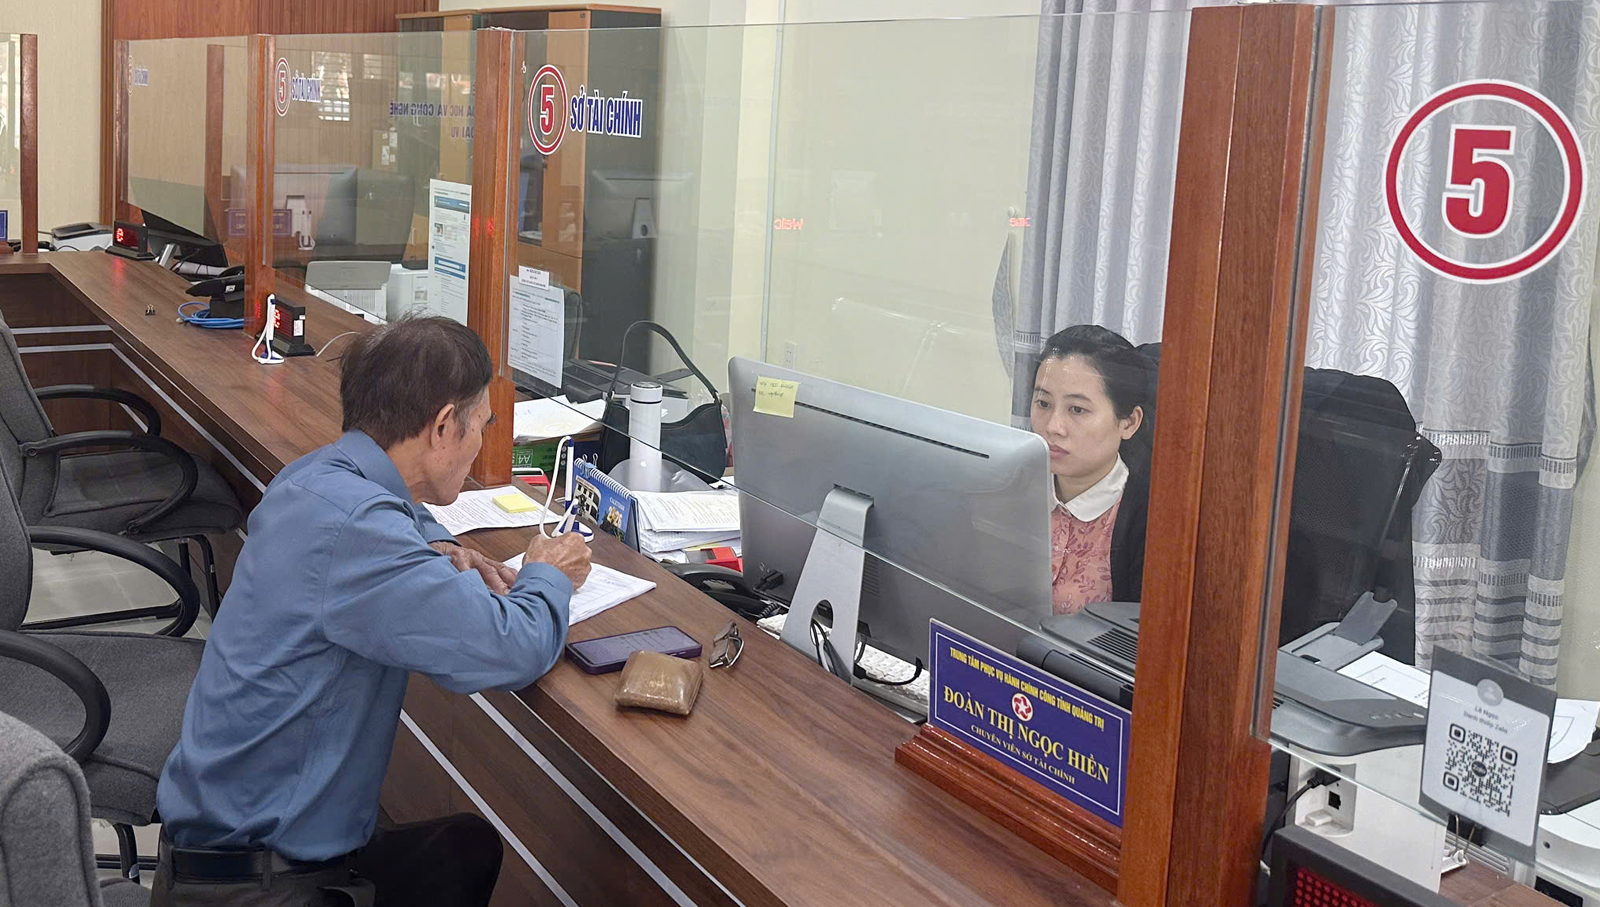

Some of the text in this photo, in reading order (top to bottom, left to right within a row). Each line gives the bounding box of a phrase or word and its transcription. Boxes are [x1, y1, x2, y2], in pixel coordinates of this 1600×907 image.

[279, 70, 286, 103] 5
[540, 84, 555, 135] 5
[570, 84, 643, 138] SỞ TÀI CHÍNH
[1441, 124, 1516, 239] 5
[950, 646, 1105, 732] TRUNG TÂM PHỤC VỤ HÀNH CHÍNH CÔNG TỈNH QUẢNG TRỊ
[944, 685, 1110, 785] ĐOÀN THỊ NGỌC HIỀN
[971, 724, 1001, 745] CHUYÊN
[1002, 740, 1021, 756] VIÊN
[1034, 757, 1047, 771] TÀI
[1048, 765, 1075, 785] CHÍNH
